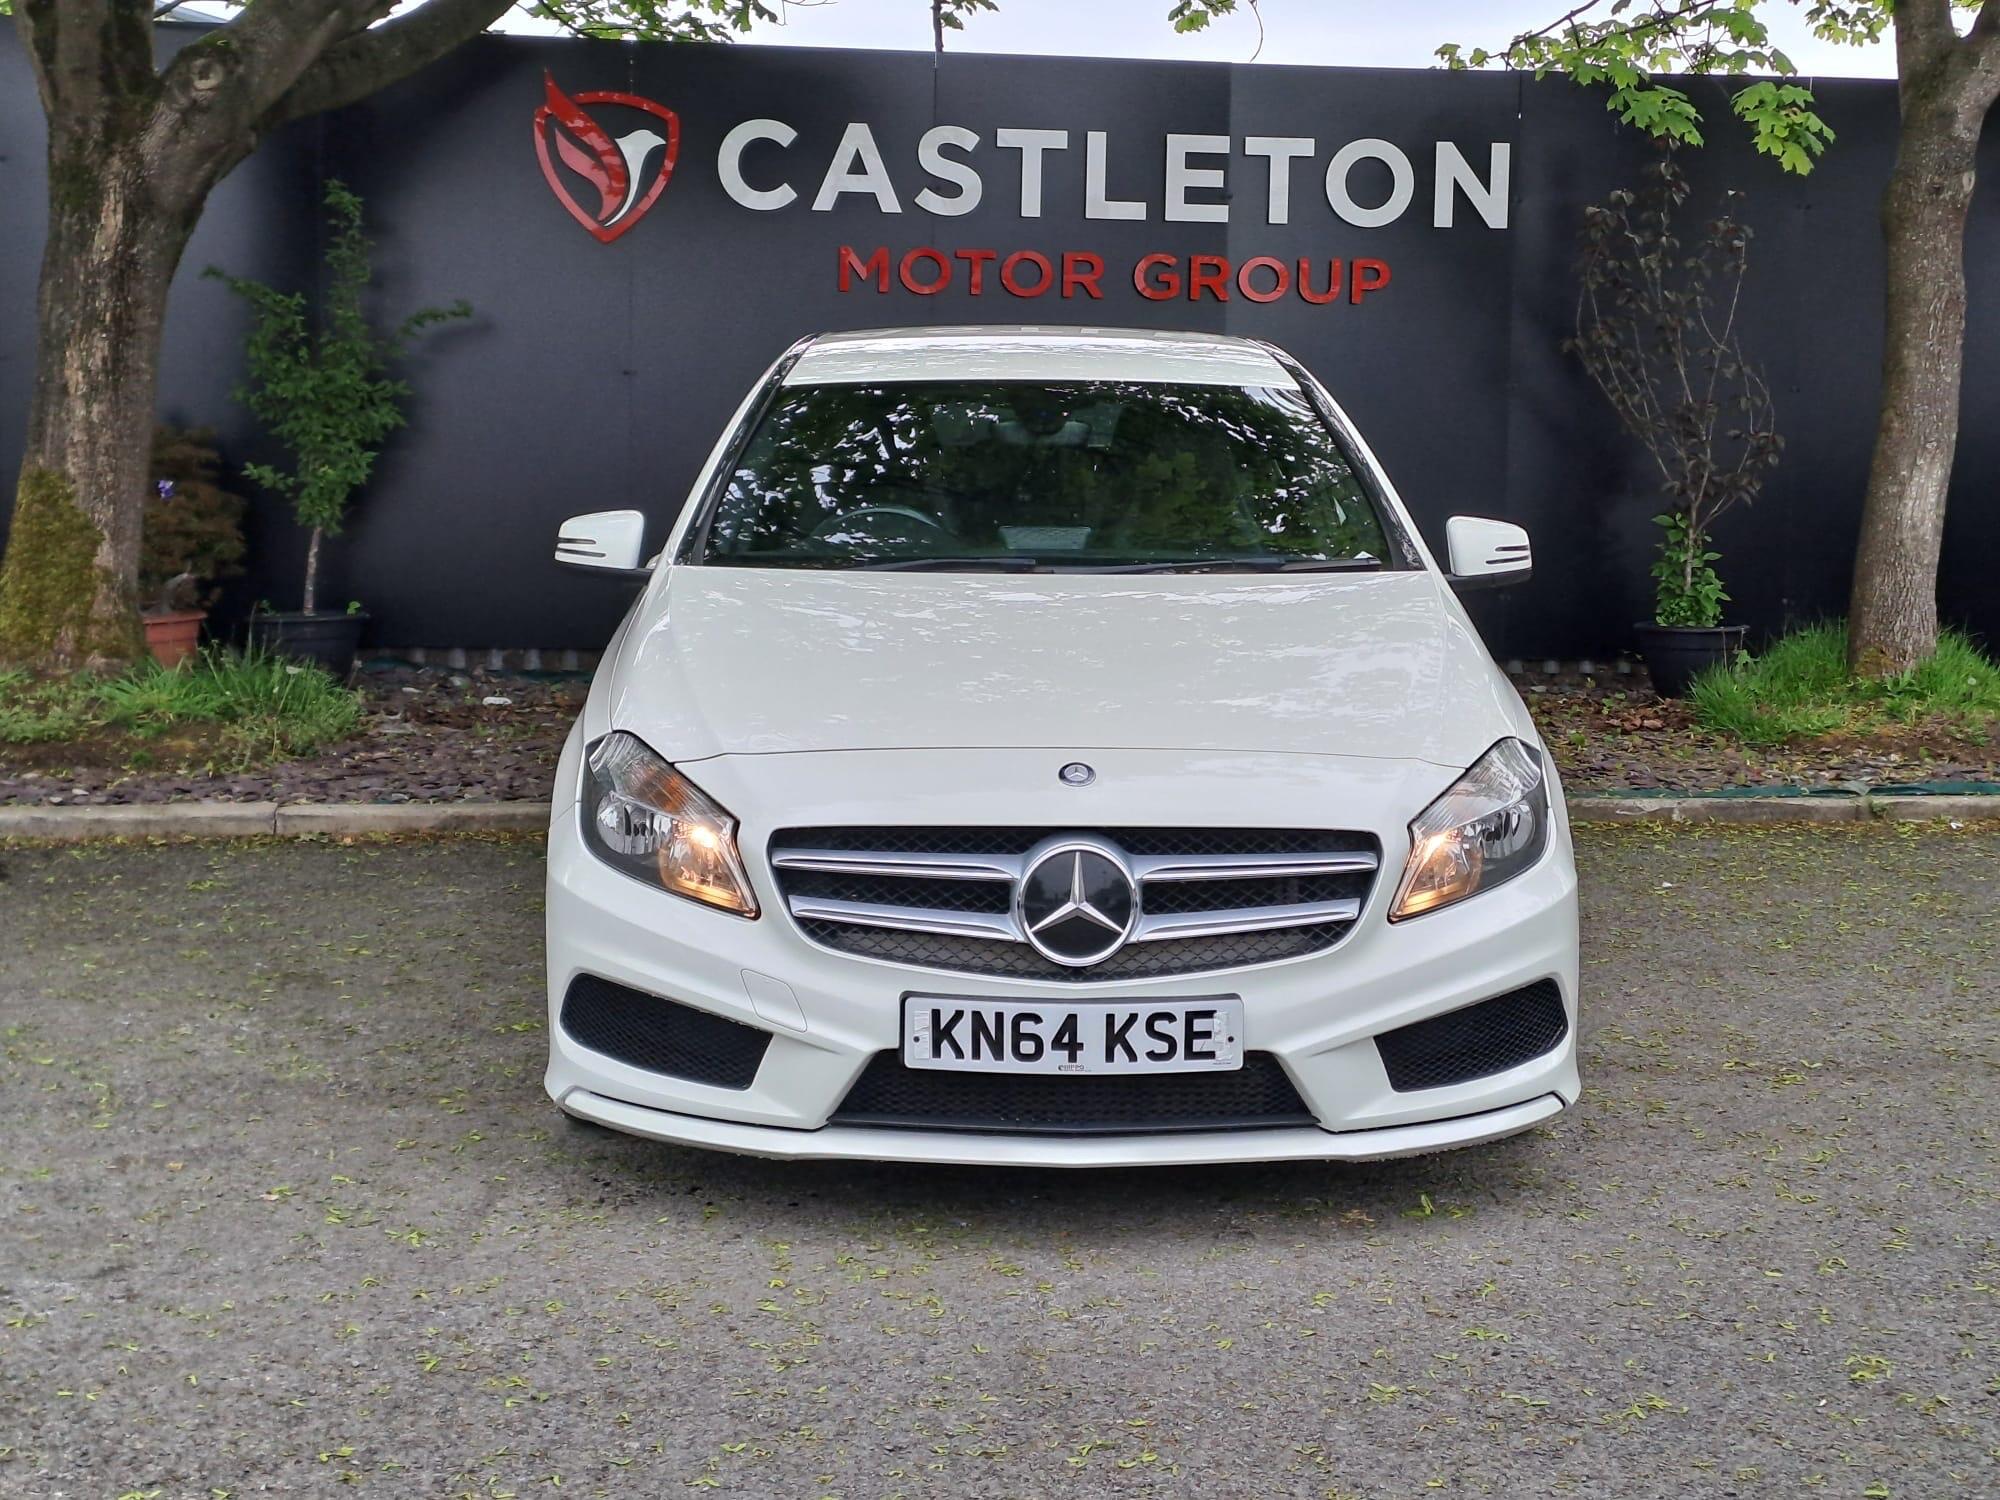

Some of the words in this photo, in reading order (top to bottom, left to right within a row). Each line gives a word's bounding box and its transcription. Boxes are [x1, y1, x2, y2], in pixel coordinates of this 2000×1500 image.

[717, 118, 1511, 229] CASTLETON
[837, 245, 1104, 299] MOTOR
[1133, 252, 1393, 304] GROUP
[931, 1008, 1084, 1063] KN64
[1105, 1009, 1217, 1063] KSE
